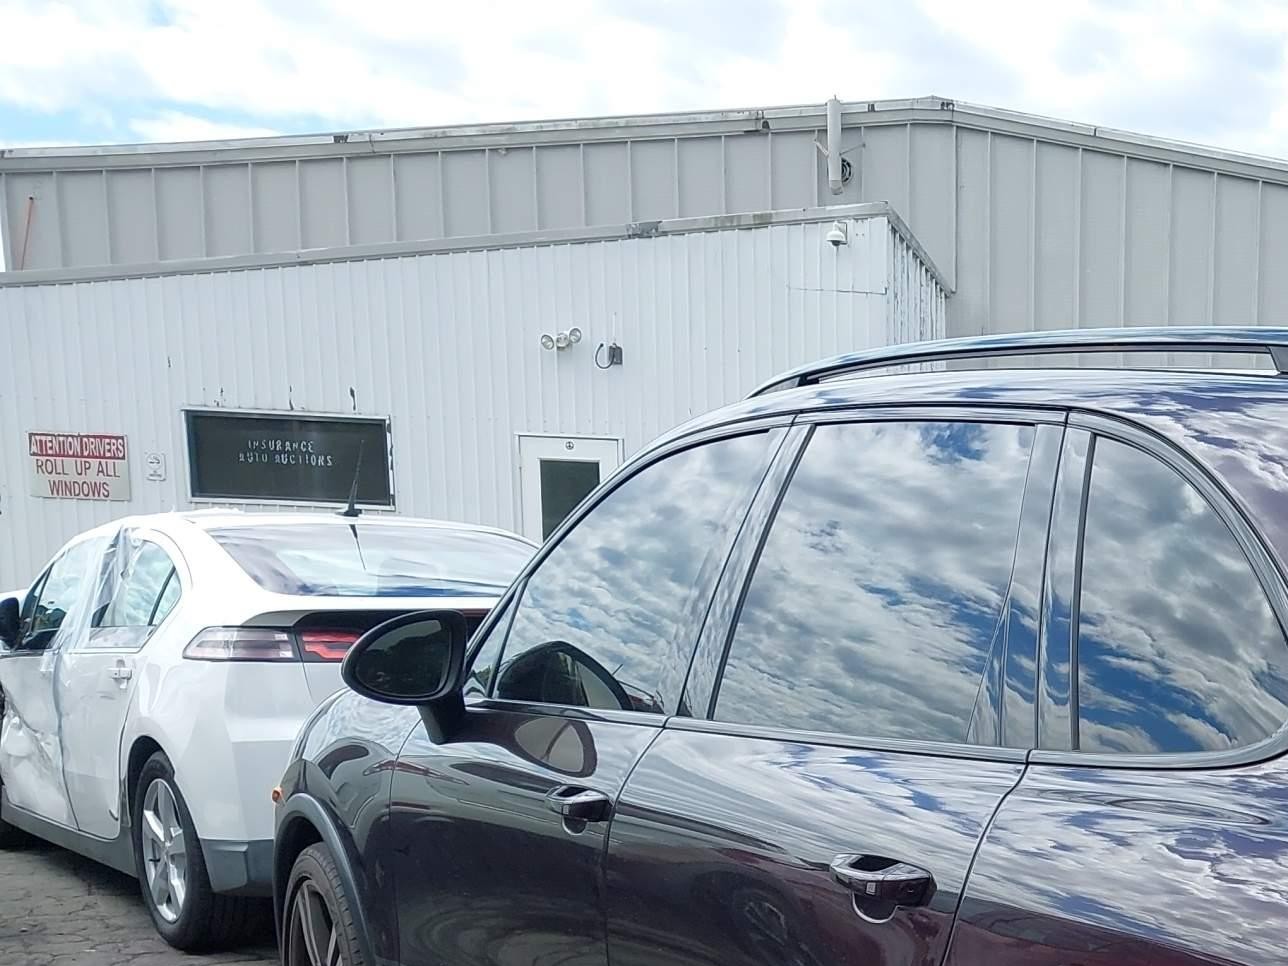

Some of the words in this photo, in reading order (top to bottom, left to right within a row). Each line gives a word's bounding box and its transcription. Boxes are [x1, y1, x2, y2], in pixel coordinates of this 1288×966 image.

[30, 434, 81, 456] ATTENTION
[82, 437, 125, 457] DRIVERS
[248, 439, 314, 453] INSURANCE
[36, 458, 69, 476] ROLL
[74, 460, 91, 477] UP
[96, 460, 120, 478] ALL
[48, 479, 110, 498] WINDOWS
